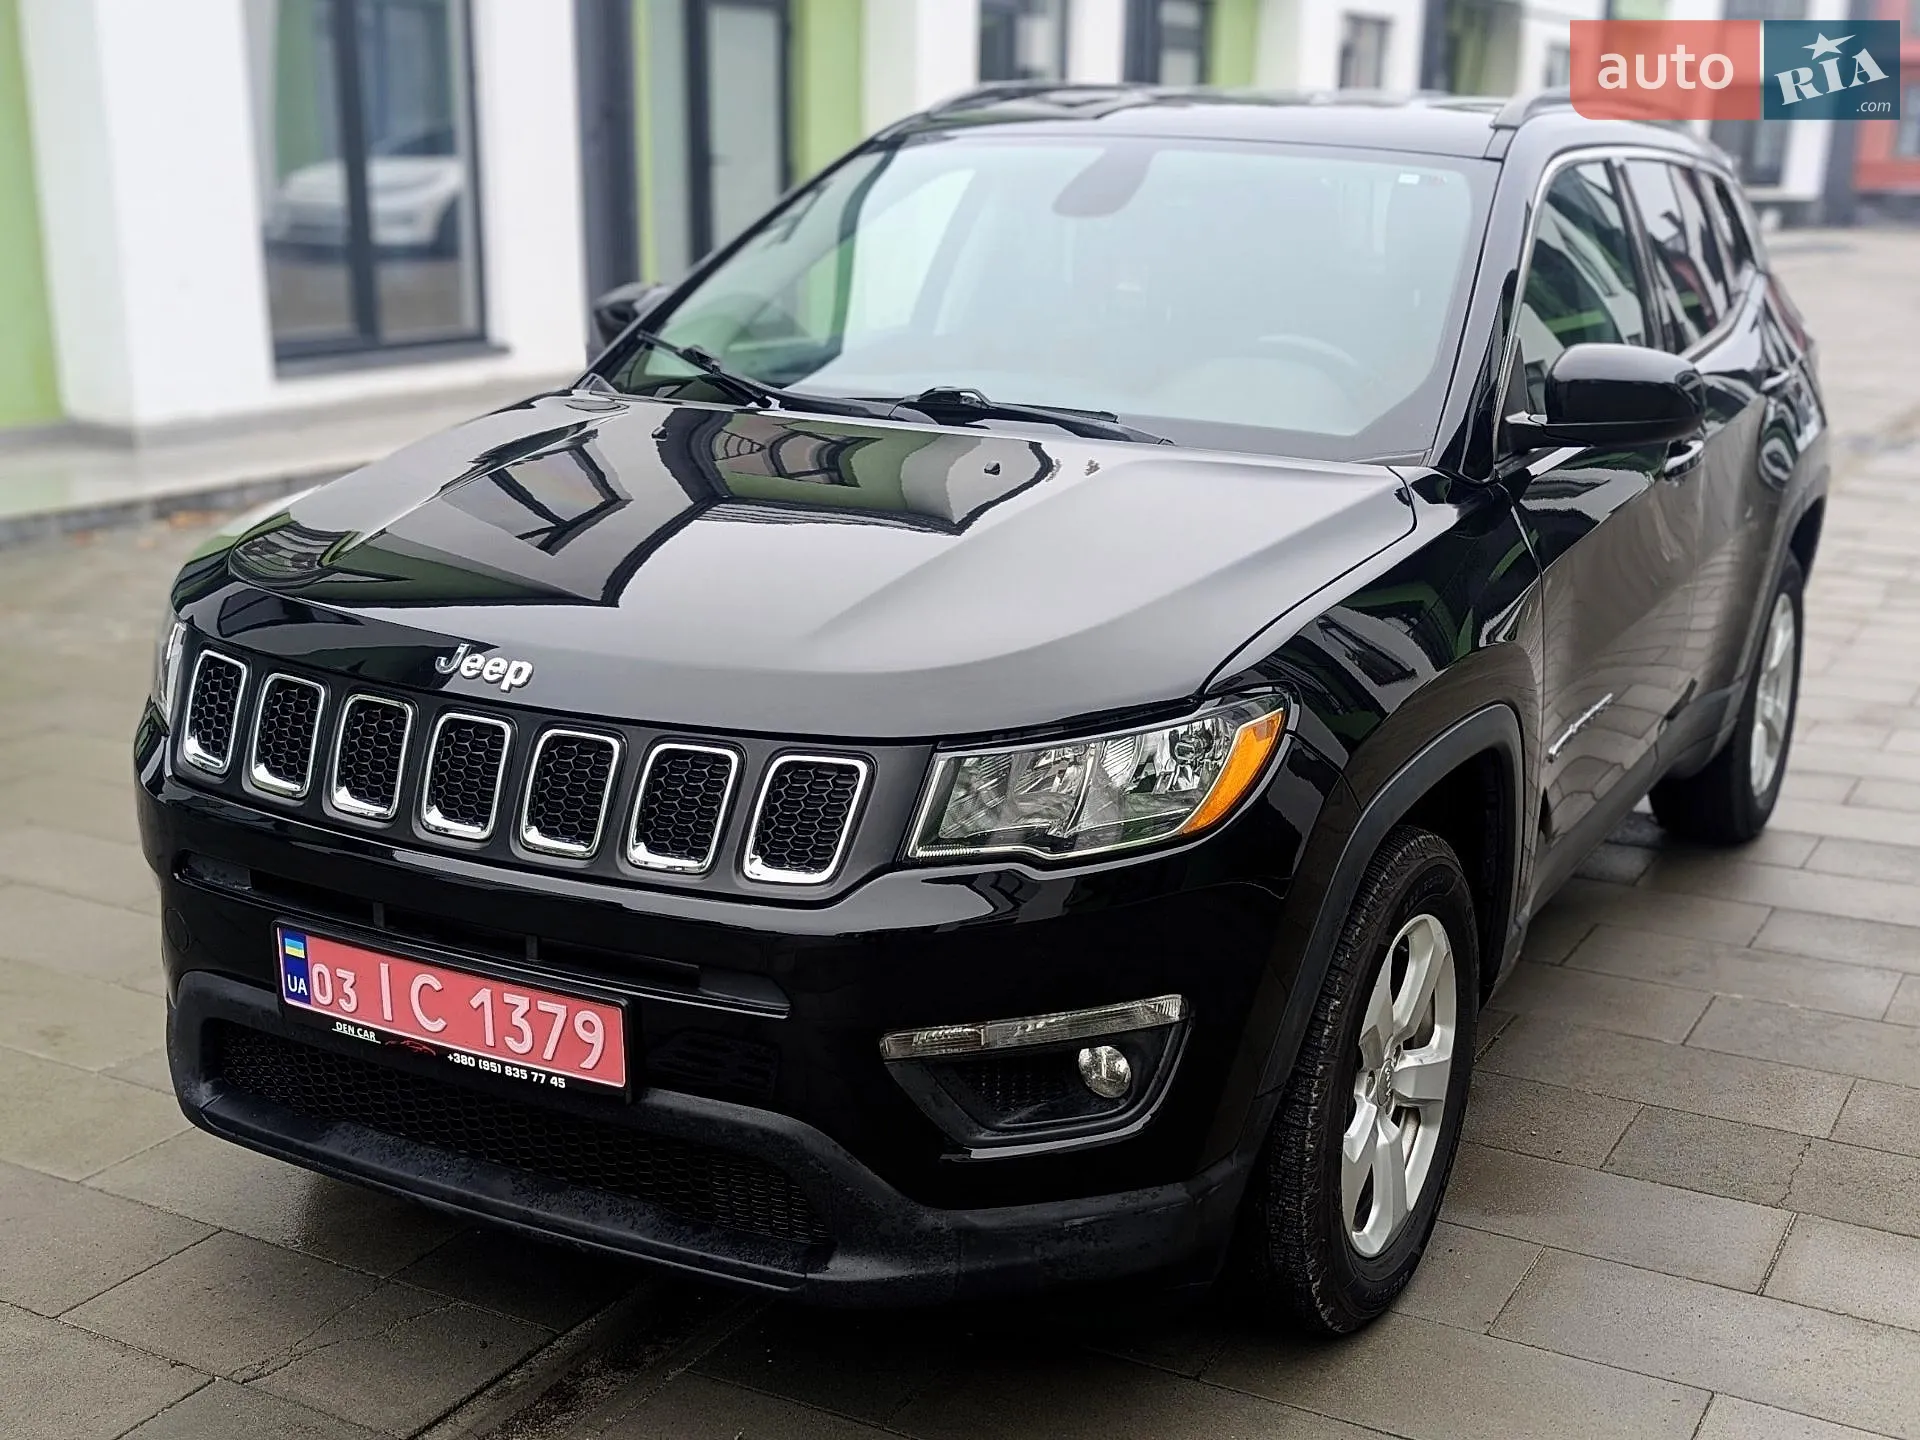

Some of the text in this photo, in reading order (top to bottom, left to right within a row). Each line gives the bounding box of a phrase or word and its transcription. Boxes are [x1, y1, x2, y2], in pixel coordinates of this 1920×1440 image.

[435, 643, 534, 693] Jeep
[287, 974, 308, 996] UA
[312, 963, 358, 1013] 03
[470, 988, 605, 1069] 1379
[335, 1021, 377, 1042] DEN CAR
[447, 1053, 566, 1089] +380 (95) 835 77 45
